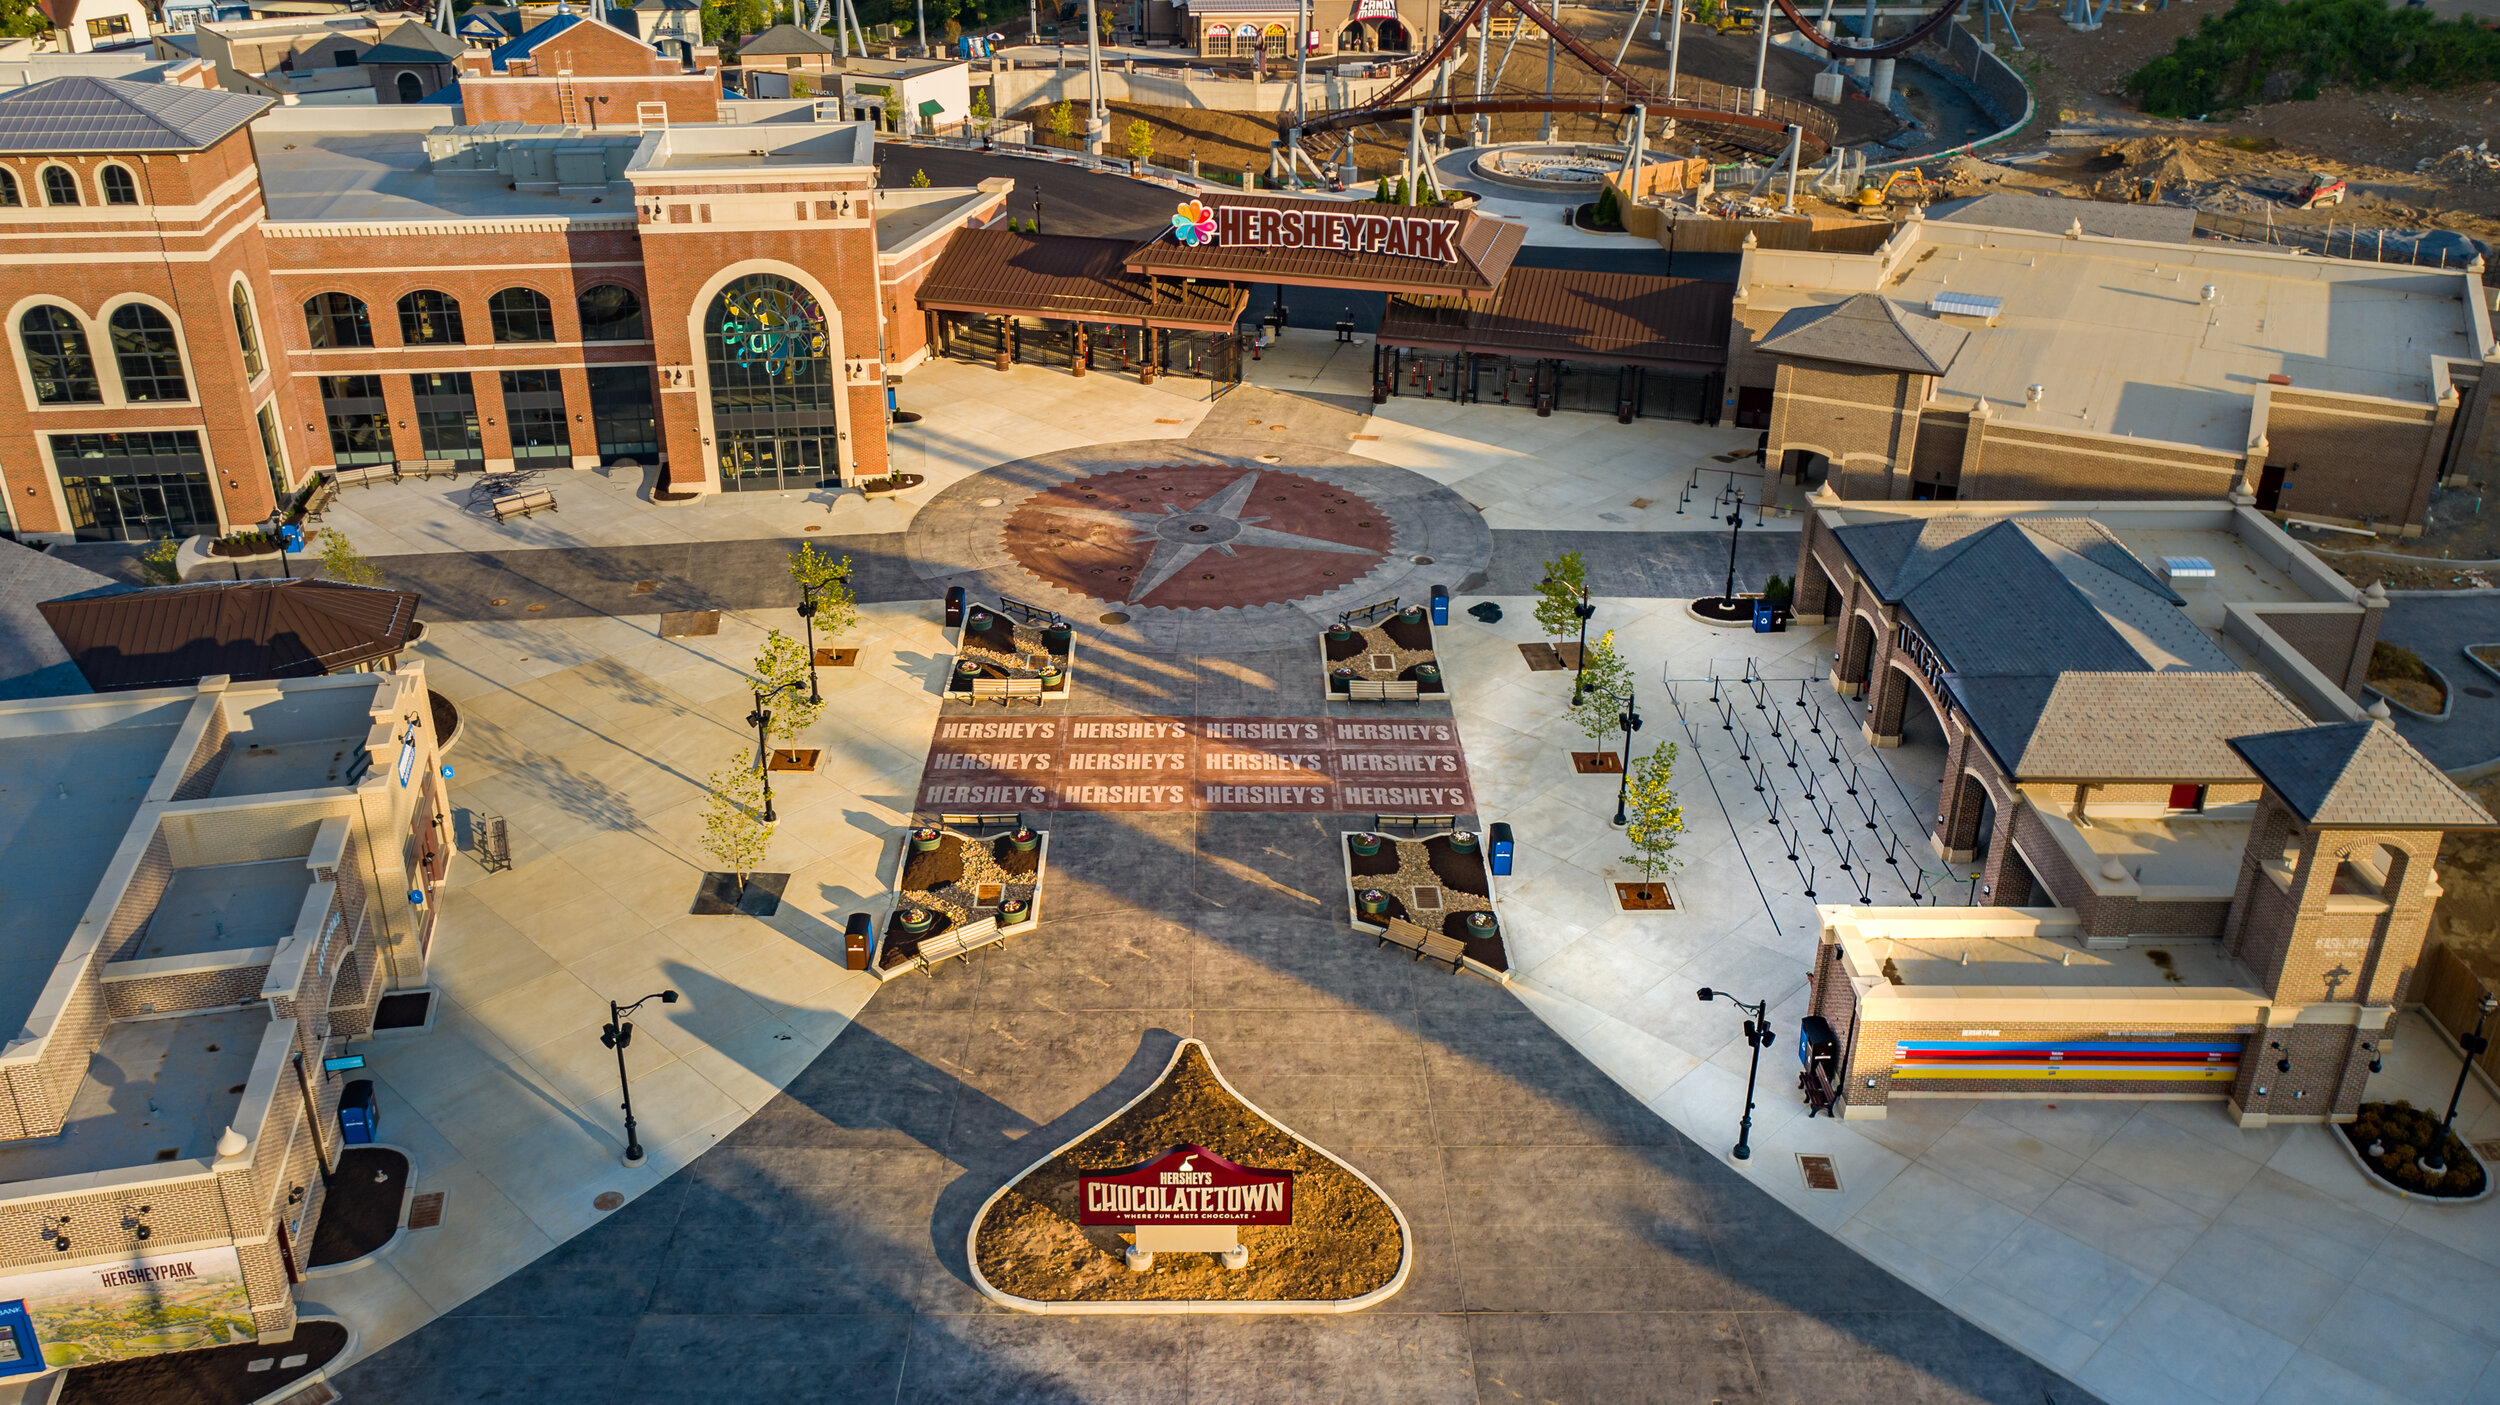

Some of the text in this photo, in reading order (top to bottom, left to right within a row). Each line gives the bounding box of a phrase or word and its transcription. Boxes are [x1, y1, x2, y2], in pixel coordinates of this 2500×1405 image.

[1219, 205, 1459, 263] HERSHEYPARK
[942, 722, 1450, 741] HERSHEY'S HERSHEY'S HERSHEY'S HERSHEY'S
[934, 752, 1457, 772] HERSHEY'S HERSHEY'S HERSHEY'S HERSHEY'S
[927, 785, 1464, 806] HERSHEY'S HERSHEY'S HERSHEY'S HERSHEY'S
[1160, 1172, 1212, 1185] HERSHEY'S
[1088, 1182, 1284, 1212] CHOCOLATETOWN
[101, 1262, 196, 1287] HERSHEYPARK
